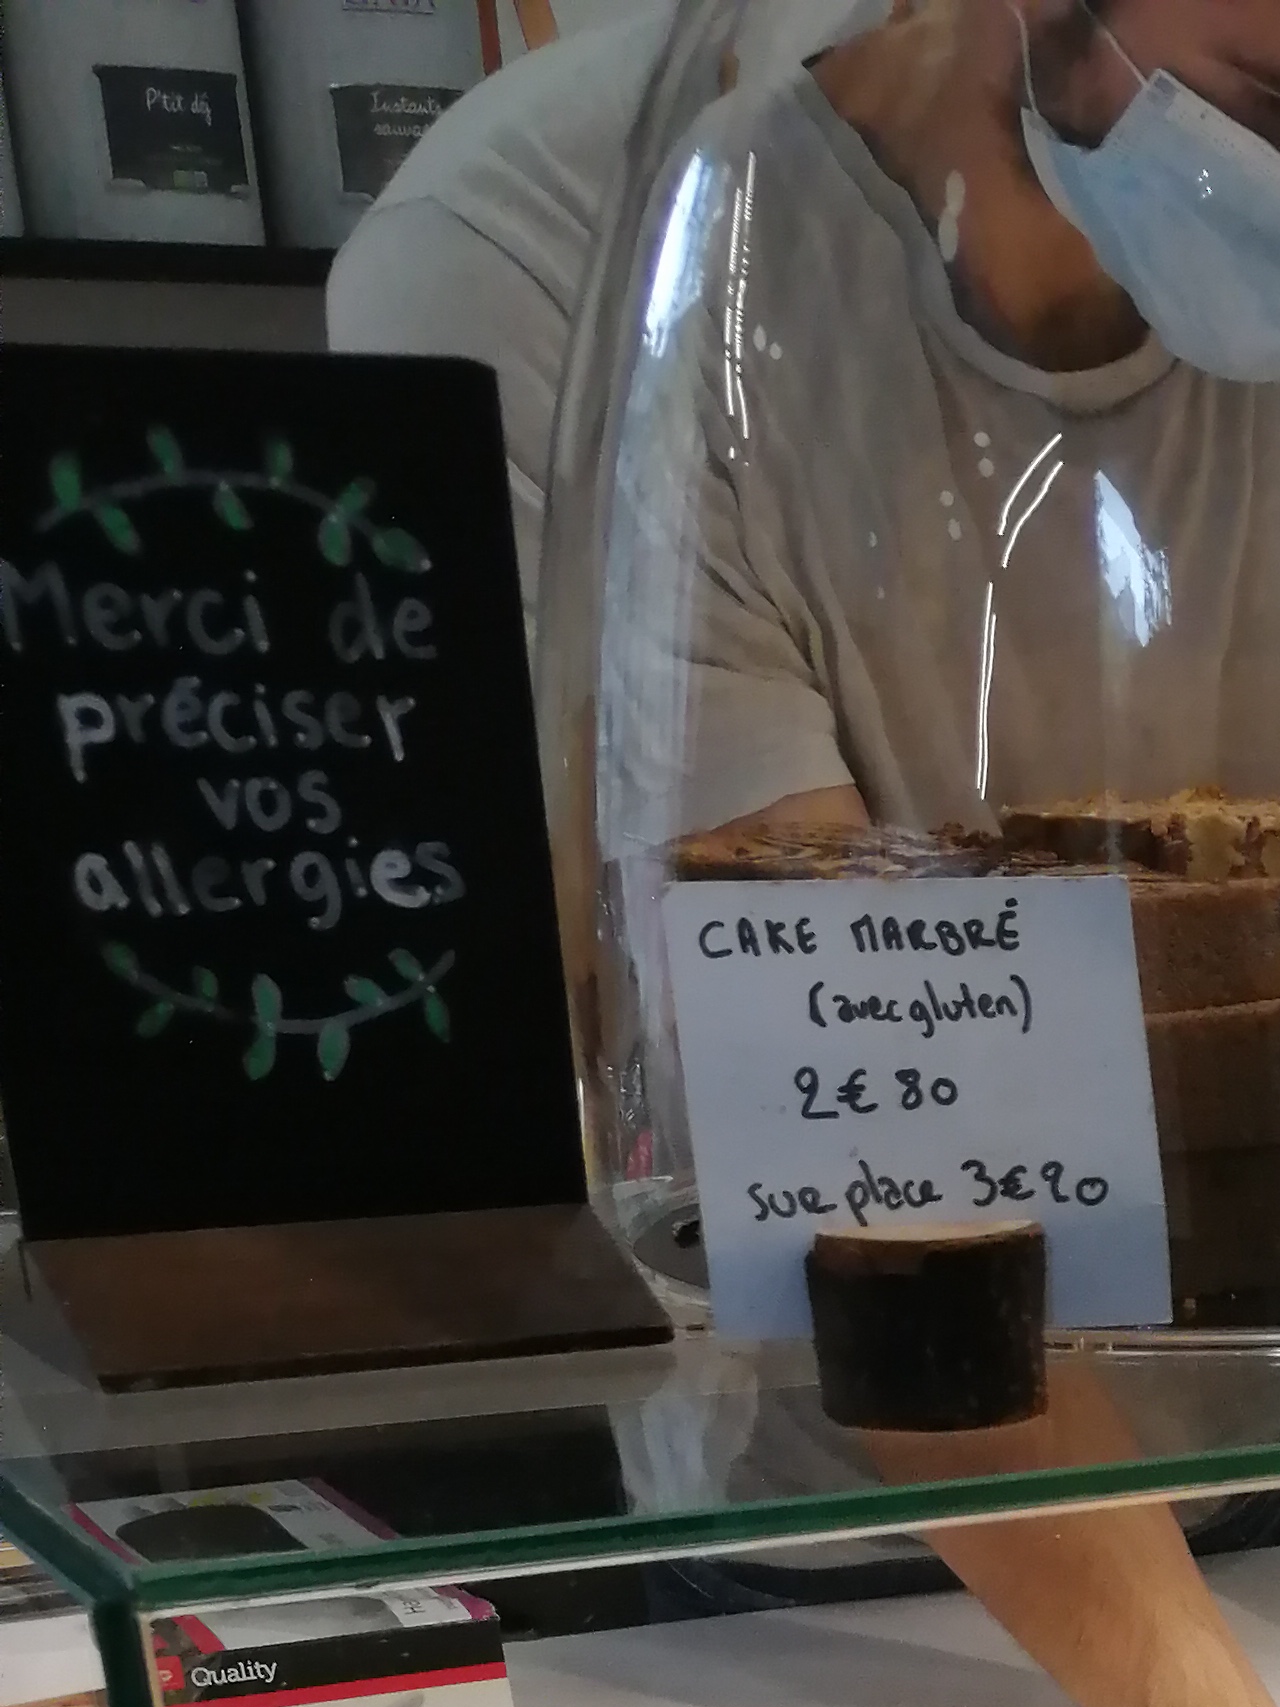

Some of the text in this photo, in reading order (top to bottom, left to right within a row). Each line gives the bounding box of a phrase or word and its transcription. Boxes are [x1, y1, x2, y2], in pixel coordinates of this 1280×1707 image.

[0, 557, 438, 664] Merci de
[57, 676, 417, 784] préciser
[198, 768, 343, 833] vos
[73, 835, 466, 931] allergies
[698, 897, 1022, 959] CAKE MARBRÉ
[844, 1158, 944, 1227] place
[190, 1659, 278, 1690] Quality
